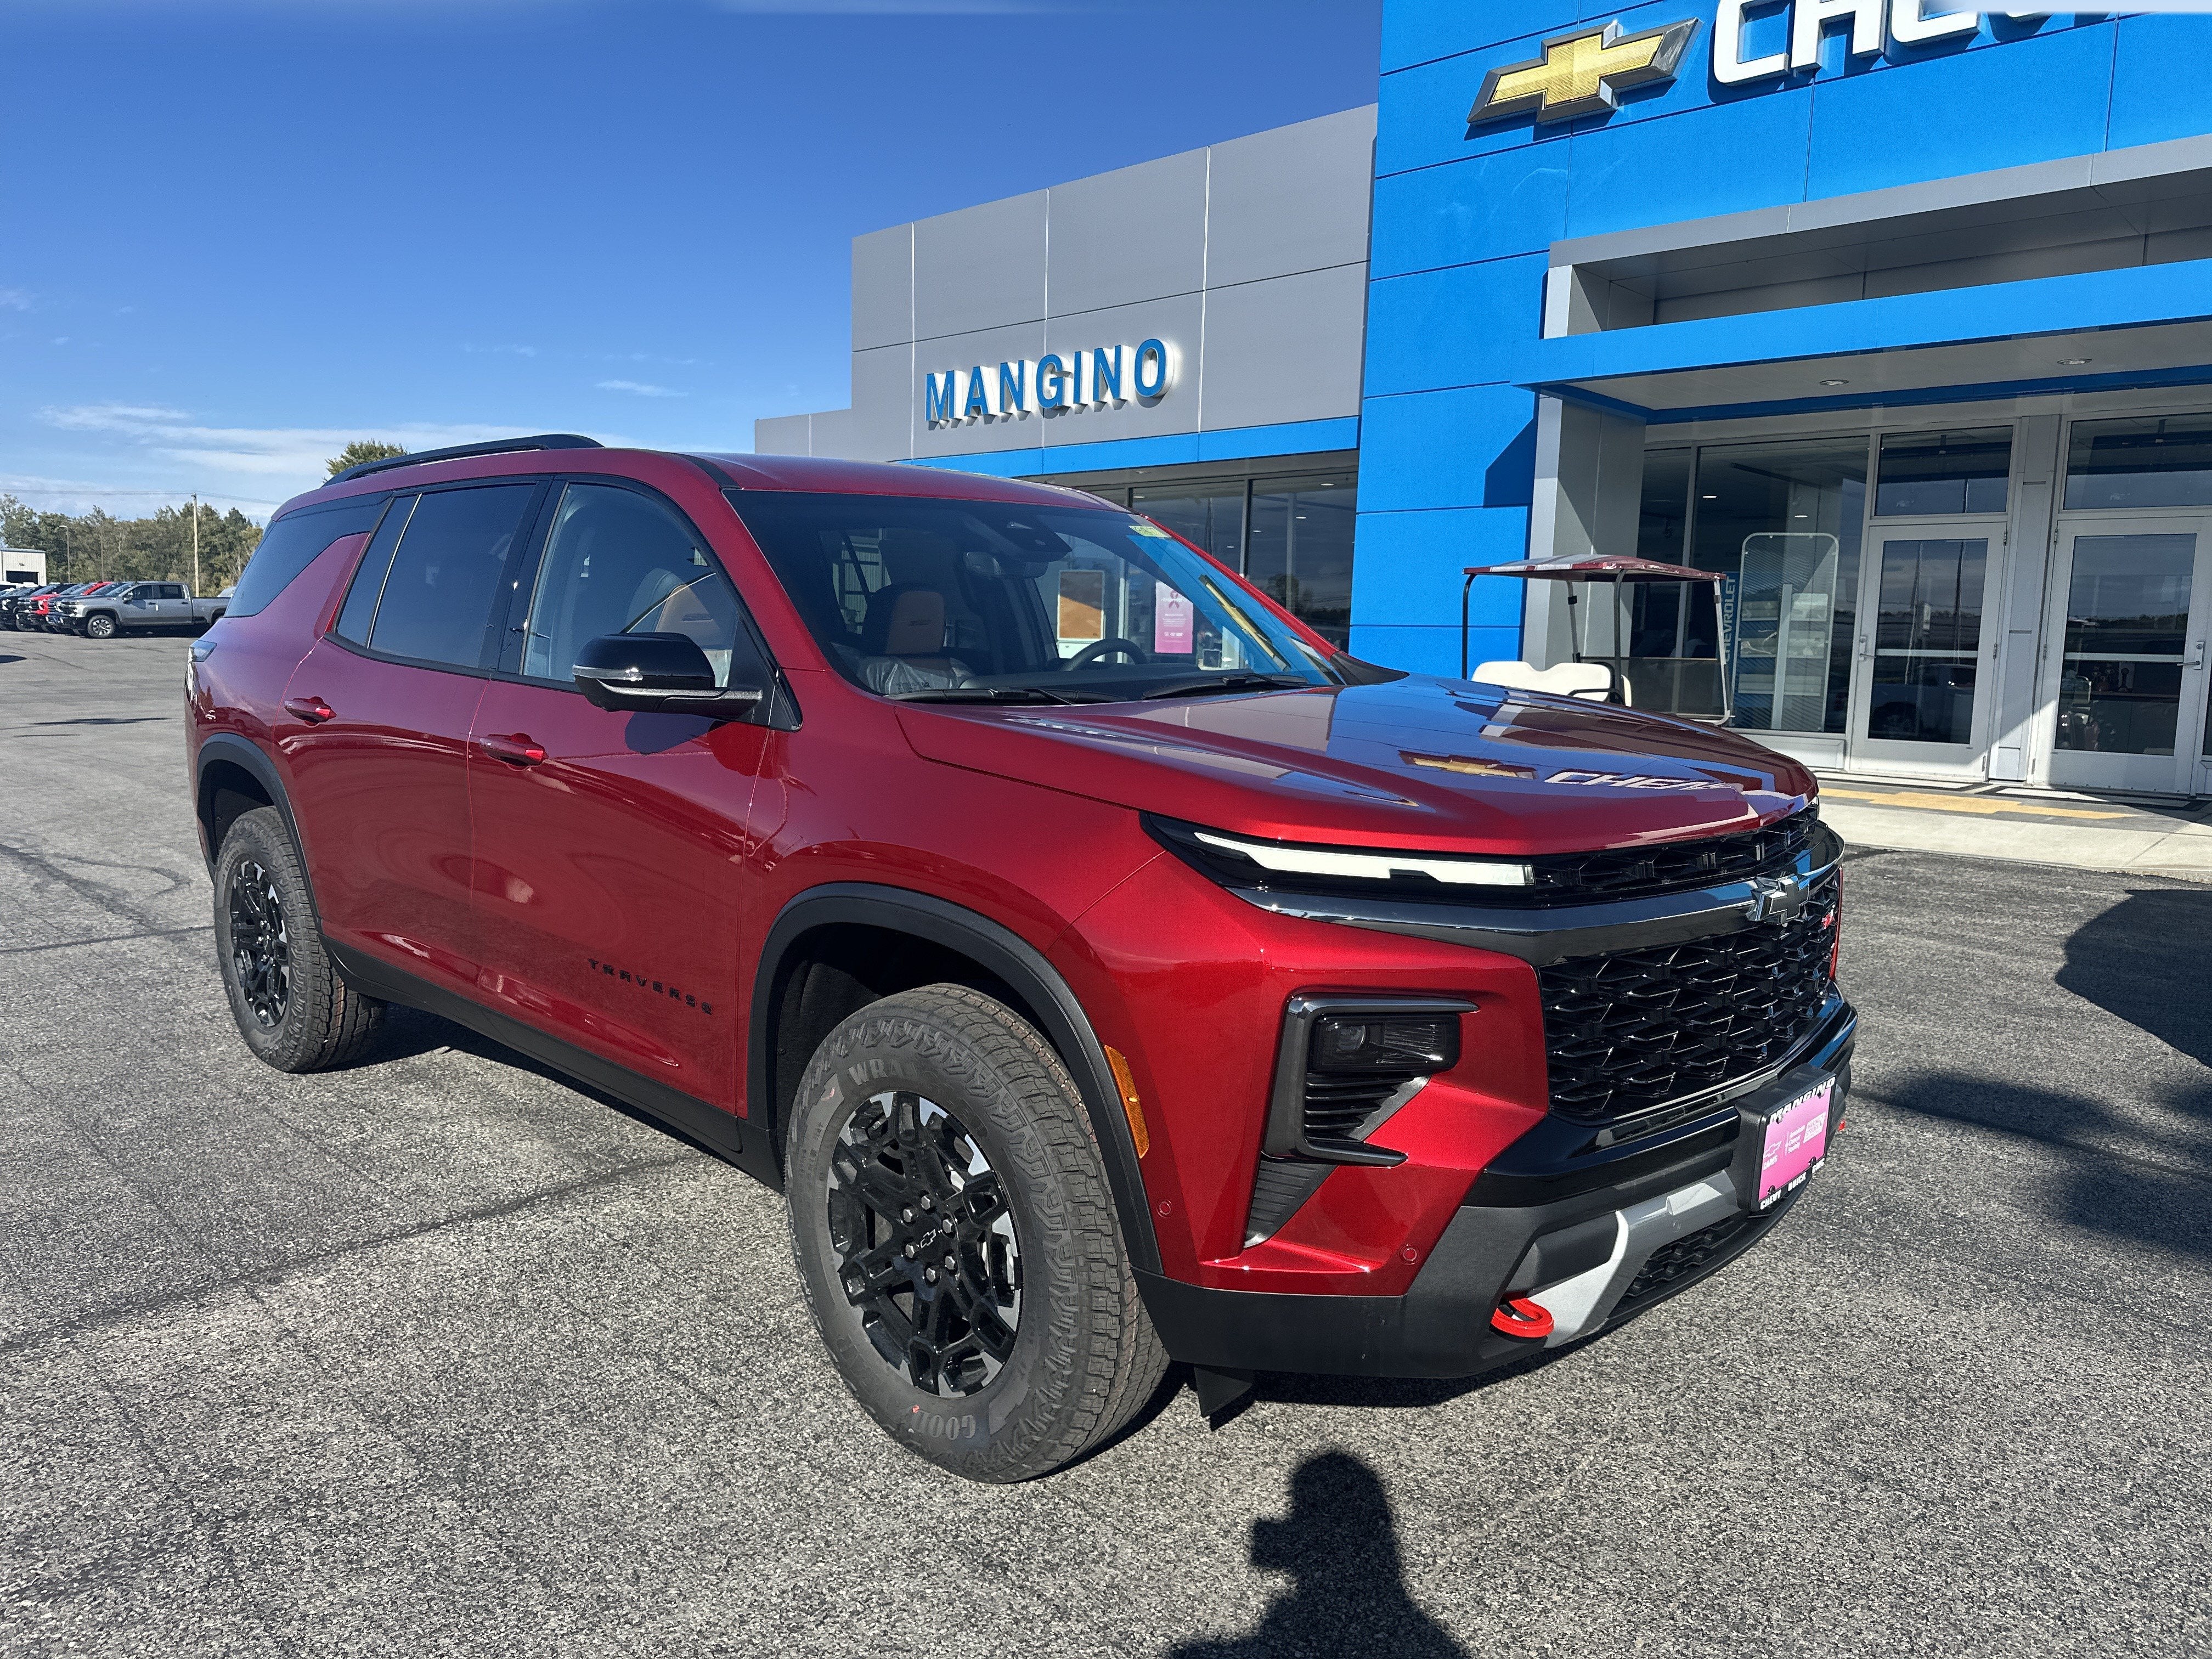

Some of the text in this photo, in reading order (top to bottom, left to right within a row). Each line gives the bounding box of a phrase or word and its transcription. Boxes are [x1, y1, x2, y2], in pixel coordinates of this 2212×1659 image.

[925, 338, 1169, 422] MANGINO
[586, 958, 713, 1015] TRAVERSE
[1769, 1076, 1836, 1125] MANGINO
[1760, 1189, 1782, 1210] CHEVY
[1788, 1172, 1807, 1192] BUICK
